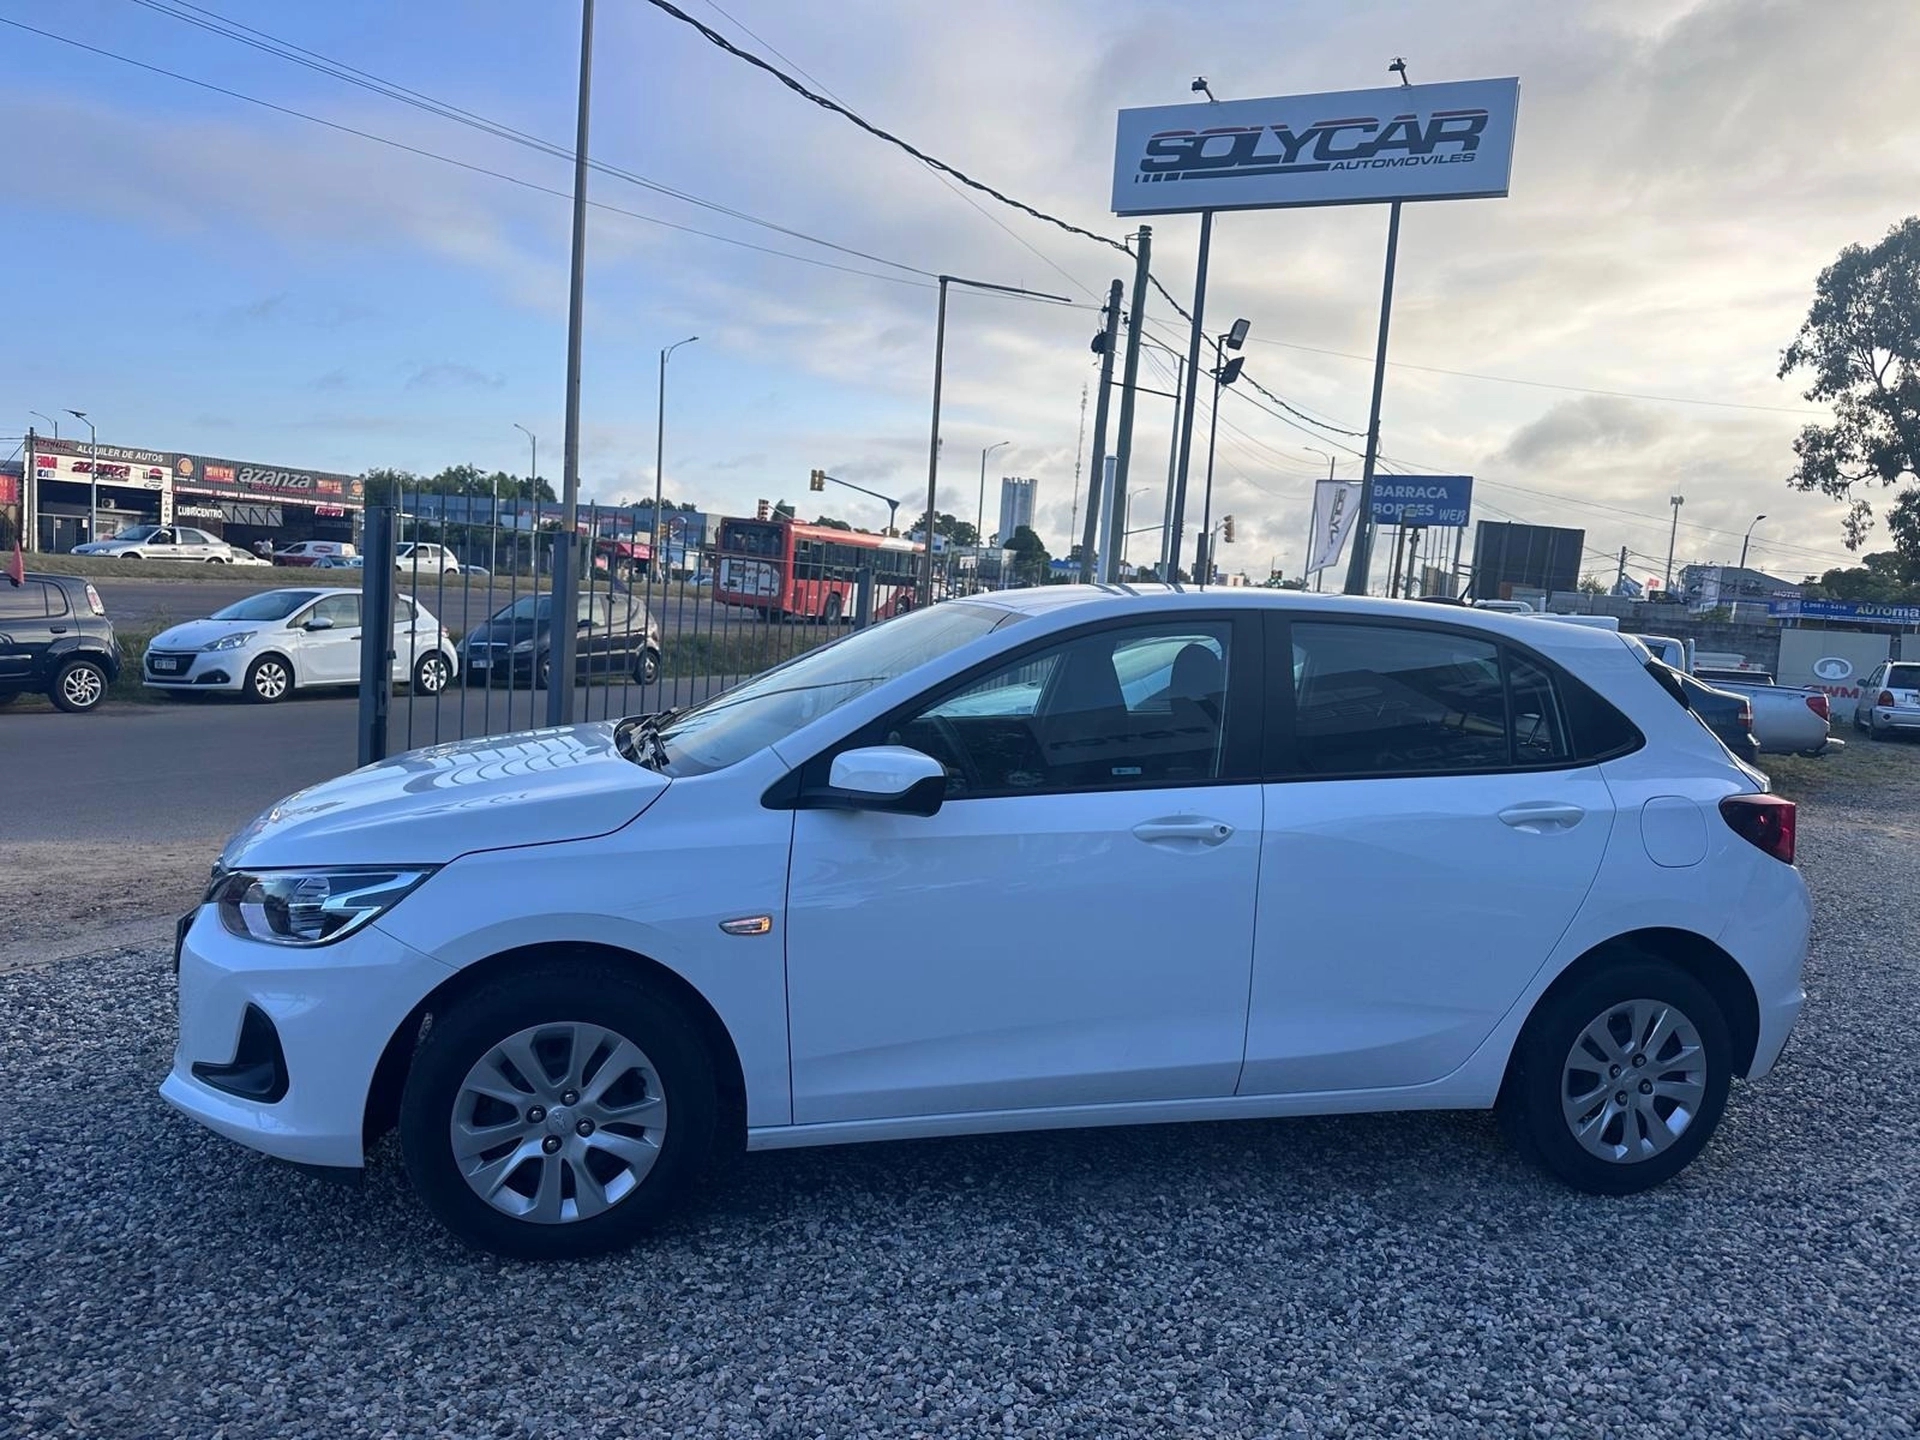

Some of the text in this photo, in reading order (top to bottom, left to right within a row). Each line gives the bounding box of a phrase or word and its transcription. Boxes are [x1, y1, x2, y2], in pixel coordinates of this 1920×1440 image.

[1140, 108, 1488, 172] SOLYCAR
[1331, 152, 1476, 172] AUTOMOVILES
[122, 450, 134, 459] DE
[135, 452, 164, 462] AUTOS
[238, 467, 311, 488] azanza
[1373, 485, 1448, 499] BARRACA
[178, 505, 222, 518] LUBRICENTRO
